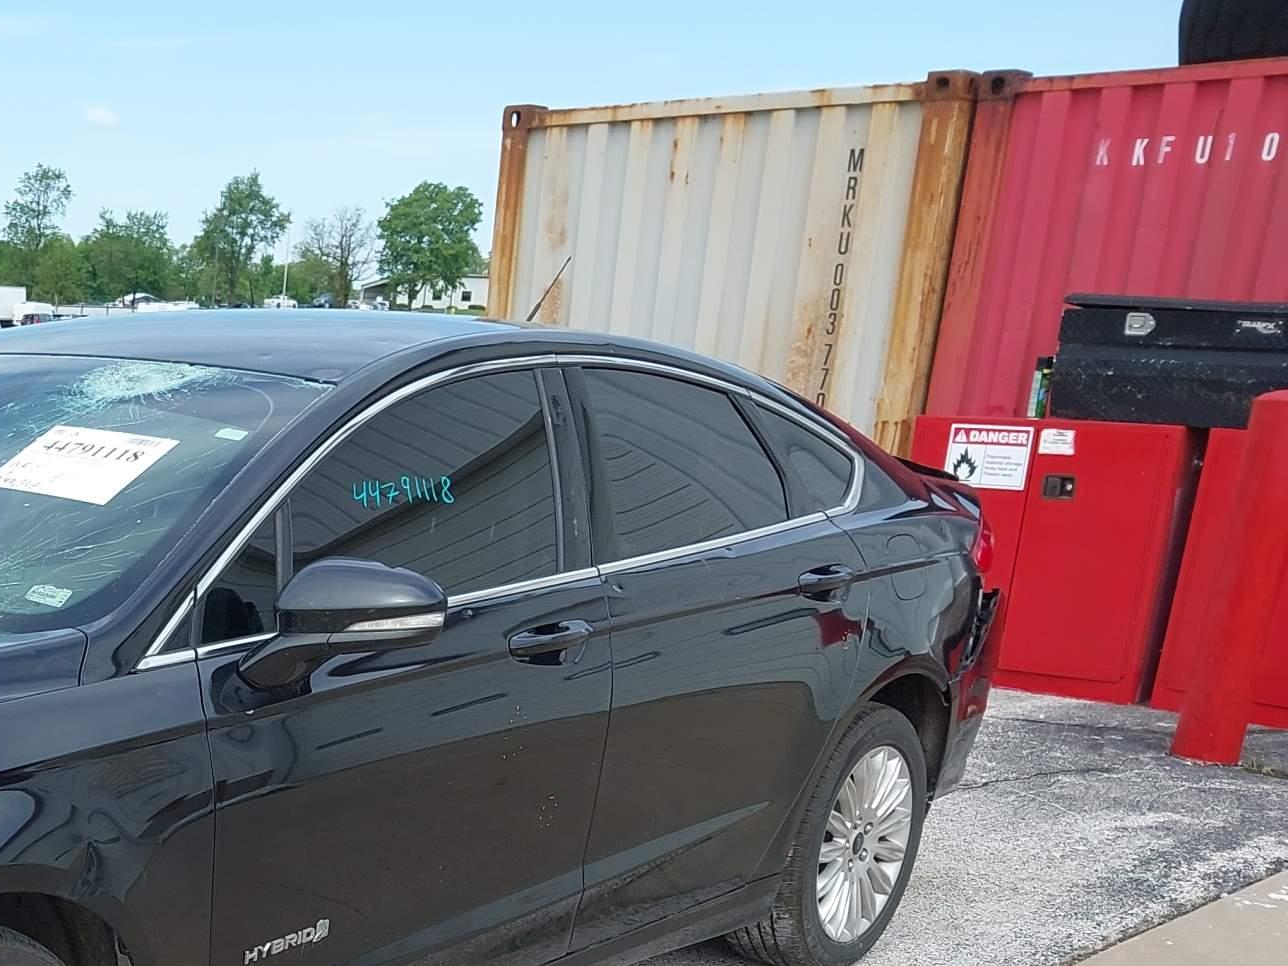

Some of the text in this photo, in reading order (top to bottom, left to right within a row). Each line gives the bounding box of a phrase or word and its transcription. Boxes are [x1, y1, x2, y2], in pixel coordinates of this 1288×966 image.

[42, 439, 146, 464] 44791118
[968, 429, 1029, 445] DANGER
[352, 475, 455, 508] 44791118
[243, 926, 316, 966] HYBRID
